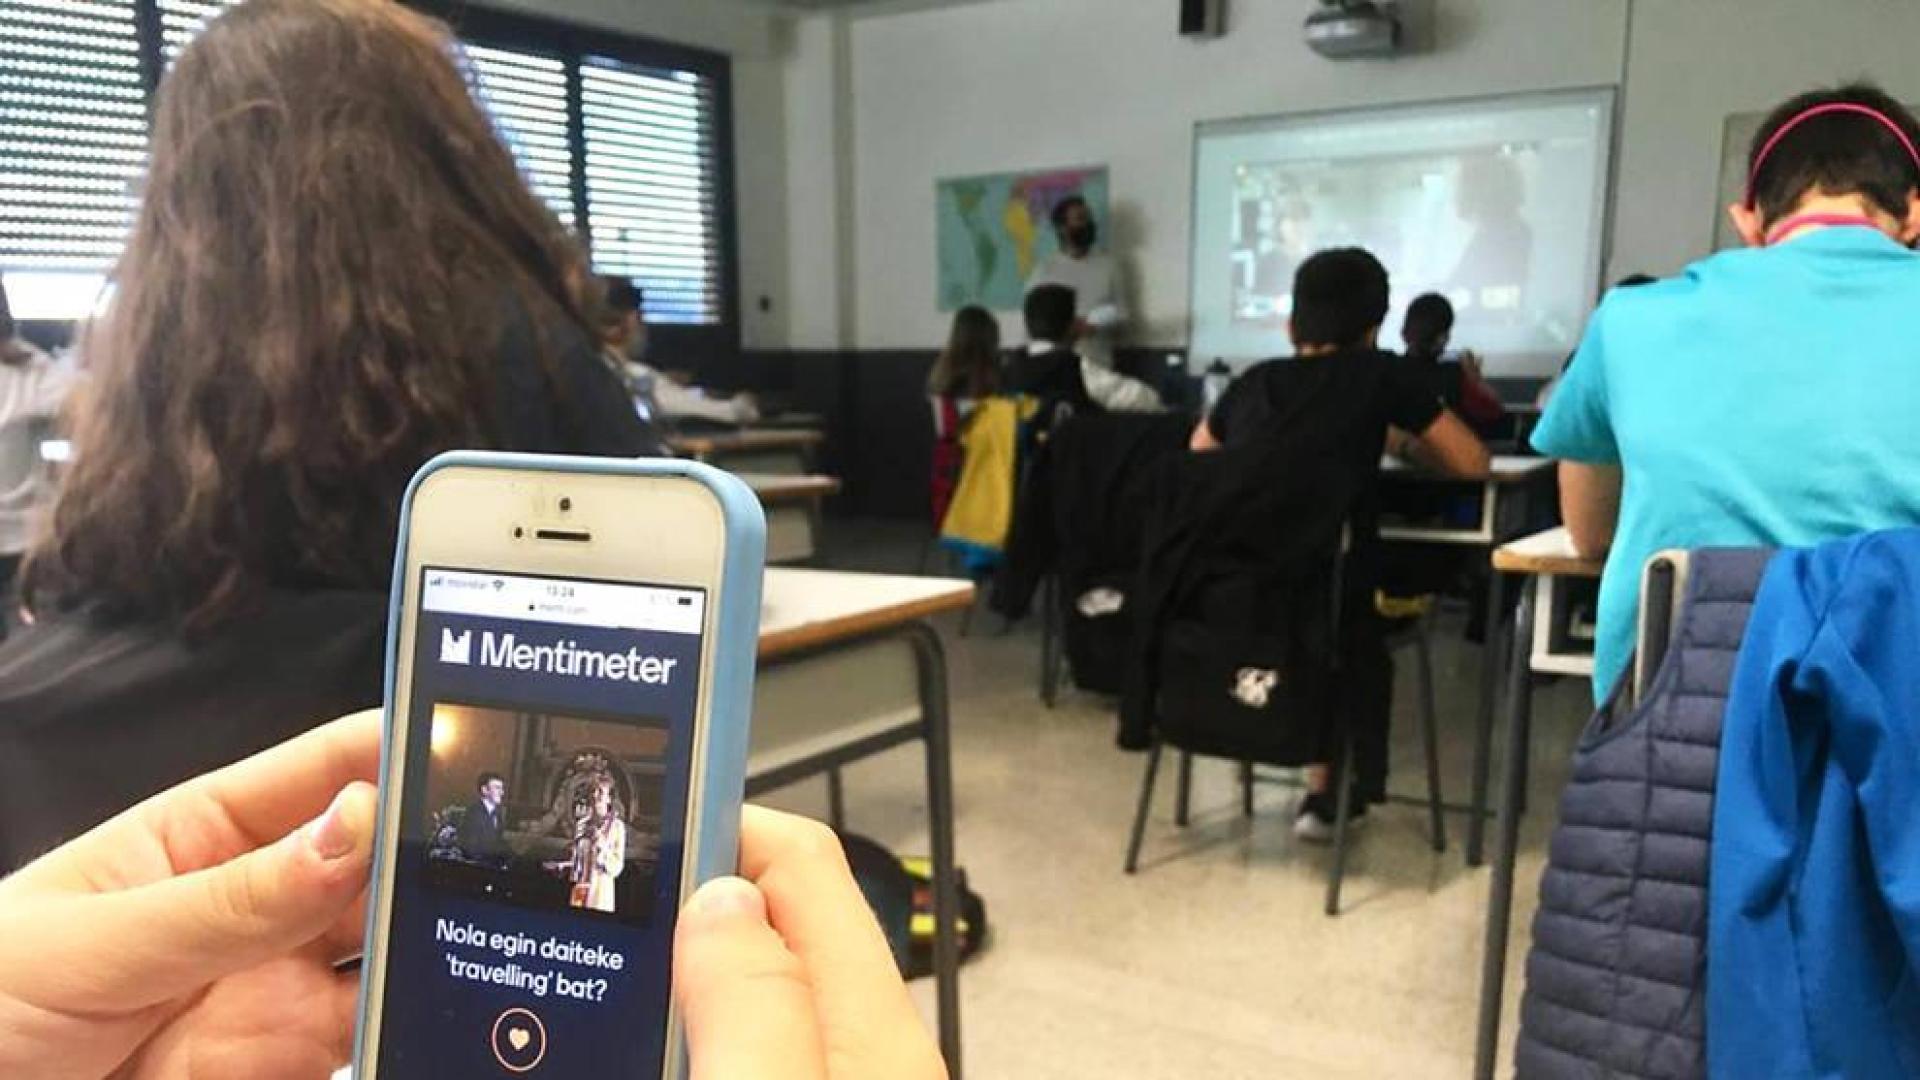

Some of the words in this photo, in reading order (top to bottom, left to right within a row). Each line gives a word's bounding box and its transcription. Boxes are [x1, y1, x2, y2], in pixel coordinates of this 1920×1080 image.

[480, 631, 677, 685] Mentimeter
[435, 918, 486, 948] Nola
[490, 931, 536, 957] egin
[540, 936, 624, 970] daiteke
[446, 953, 554, 996] 'travelling'
[556, 972, 608, 1001] bat?
